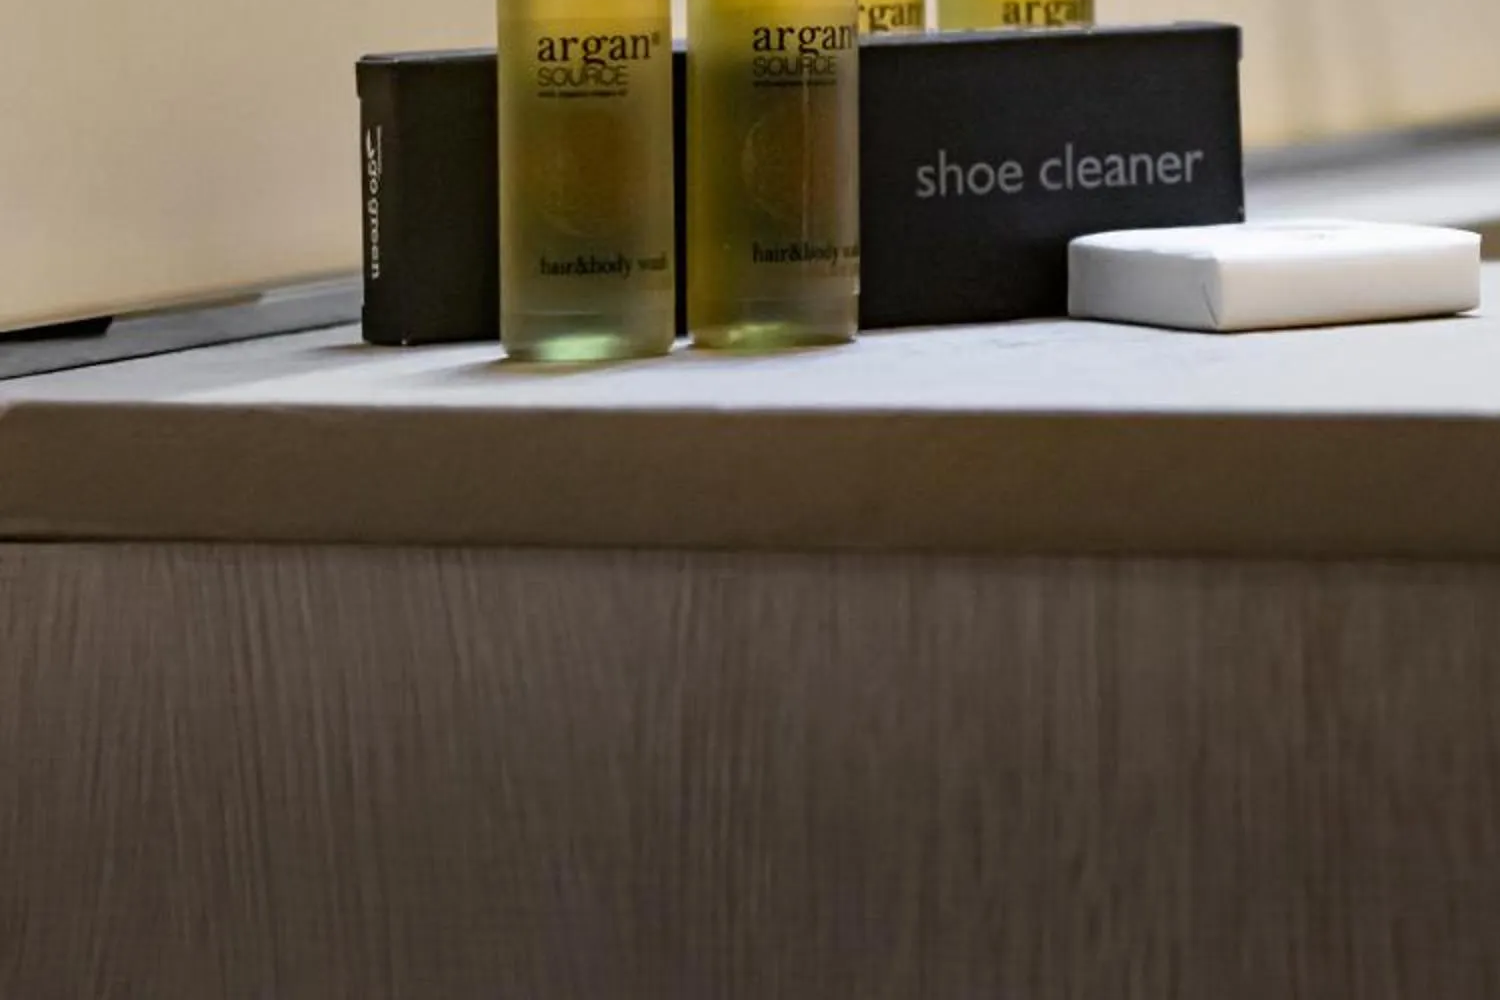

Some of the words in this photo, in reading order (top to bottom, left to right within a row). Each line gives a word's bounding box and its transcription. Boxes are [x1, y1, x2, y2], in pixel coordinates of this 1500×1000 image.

[537, 65, 630, 87] SOURCE
[752, 55, 838, 77] SOURCE
[367, 159, 380, 195] go
[915, 148, 1024, 198] shoe
[1038, 142, 1204, 191] cleaner
[367, 197, 380, 280] green
